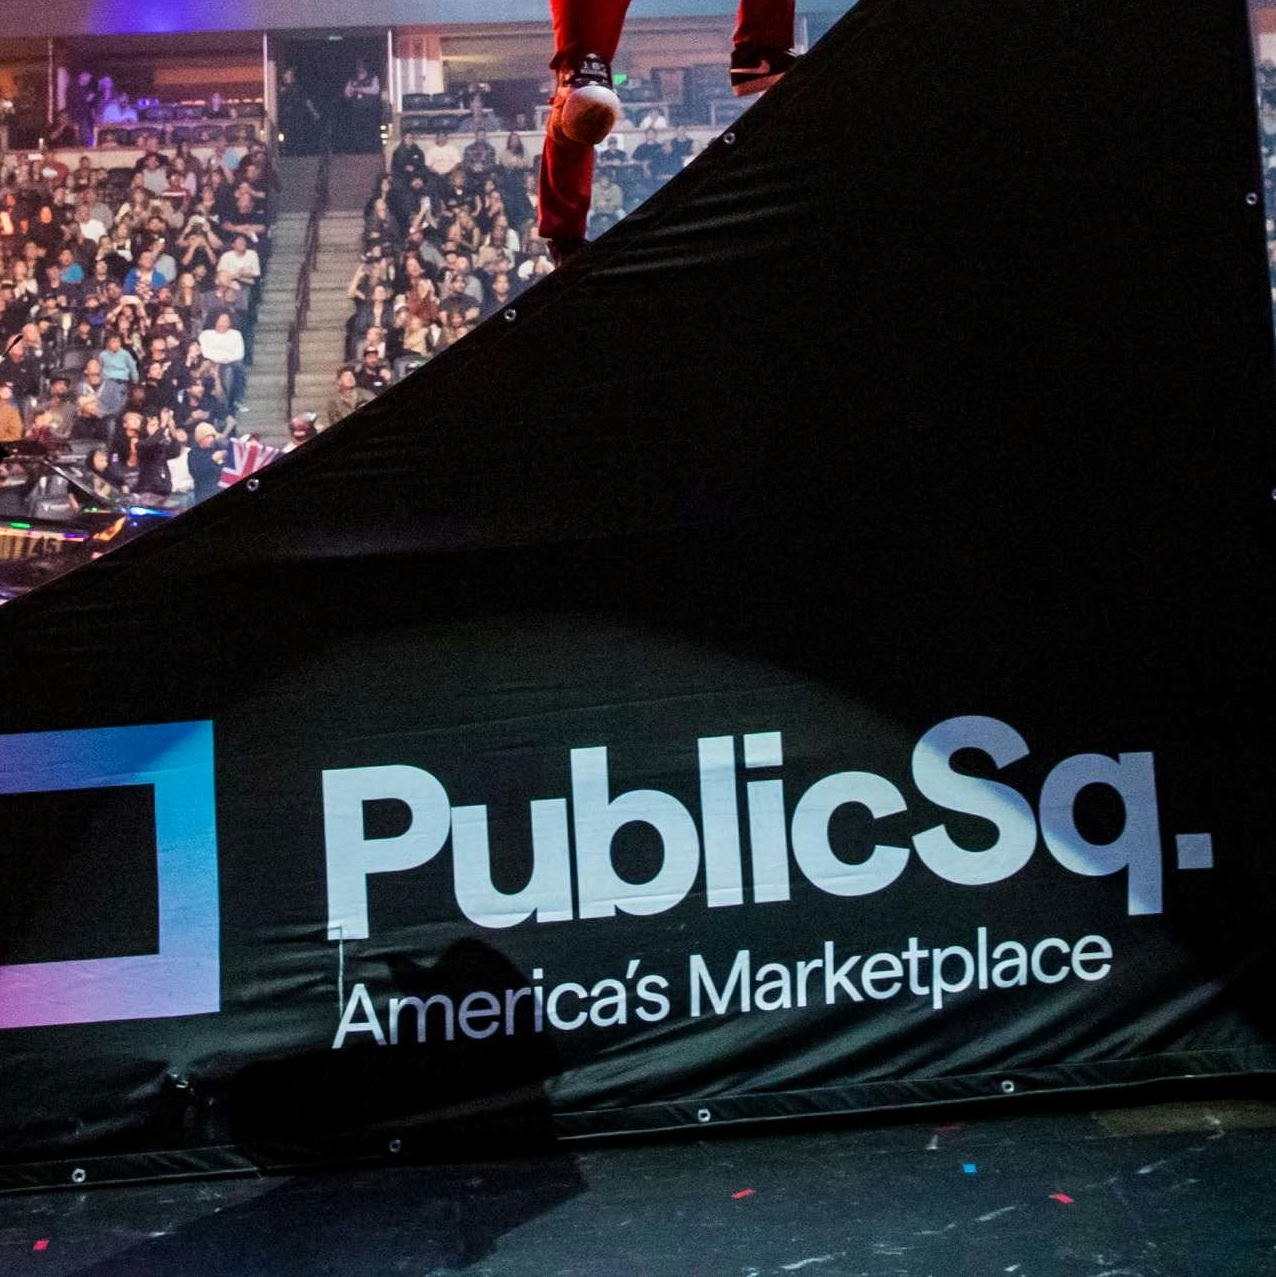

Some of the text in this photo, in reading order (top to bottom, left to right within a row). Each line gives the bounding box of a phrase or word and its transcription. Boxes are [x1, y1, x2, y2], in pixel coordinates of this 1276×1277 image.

[321, 714, 1214, 941] PublicSq.
[331, 926, 1113, 1050] America's Marketplace
